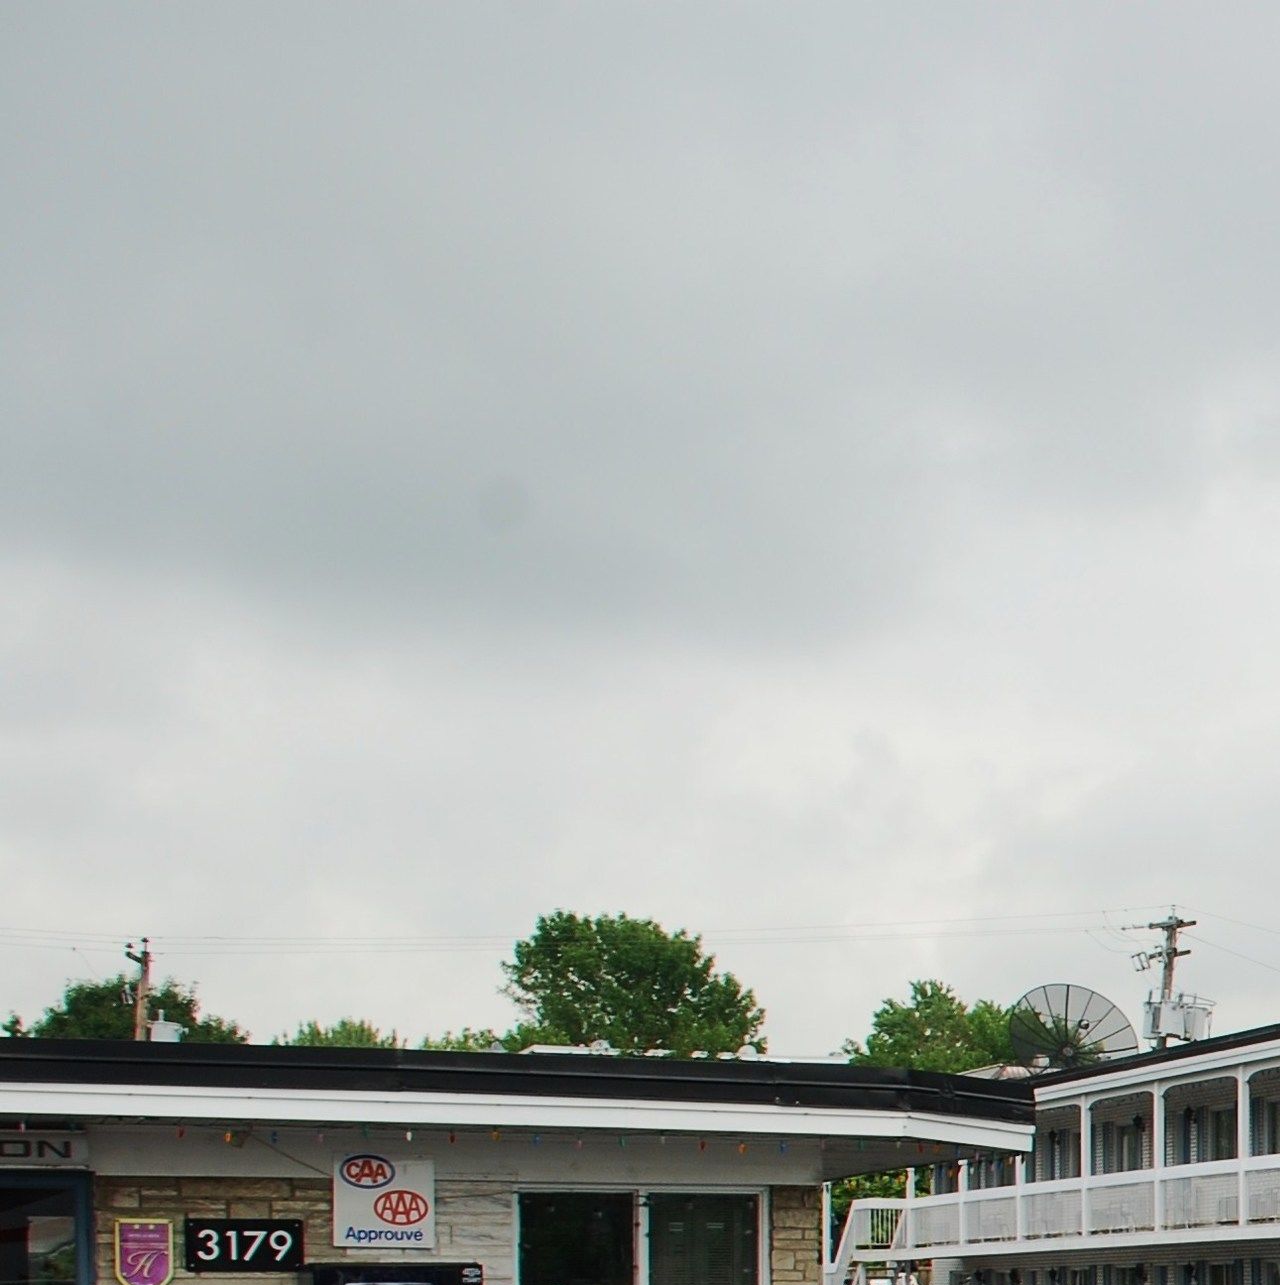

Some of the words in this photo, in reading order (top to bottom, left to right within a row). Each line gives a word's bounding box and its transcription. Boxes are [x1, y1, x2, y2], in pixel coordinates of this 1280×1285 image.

[346, 1160, 388, 1184] CAA
[379, 1191, 423, 1224] AAA
[197, 1229, 293, 1261] 3179
